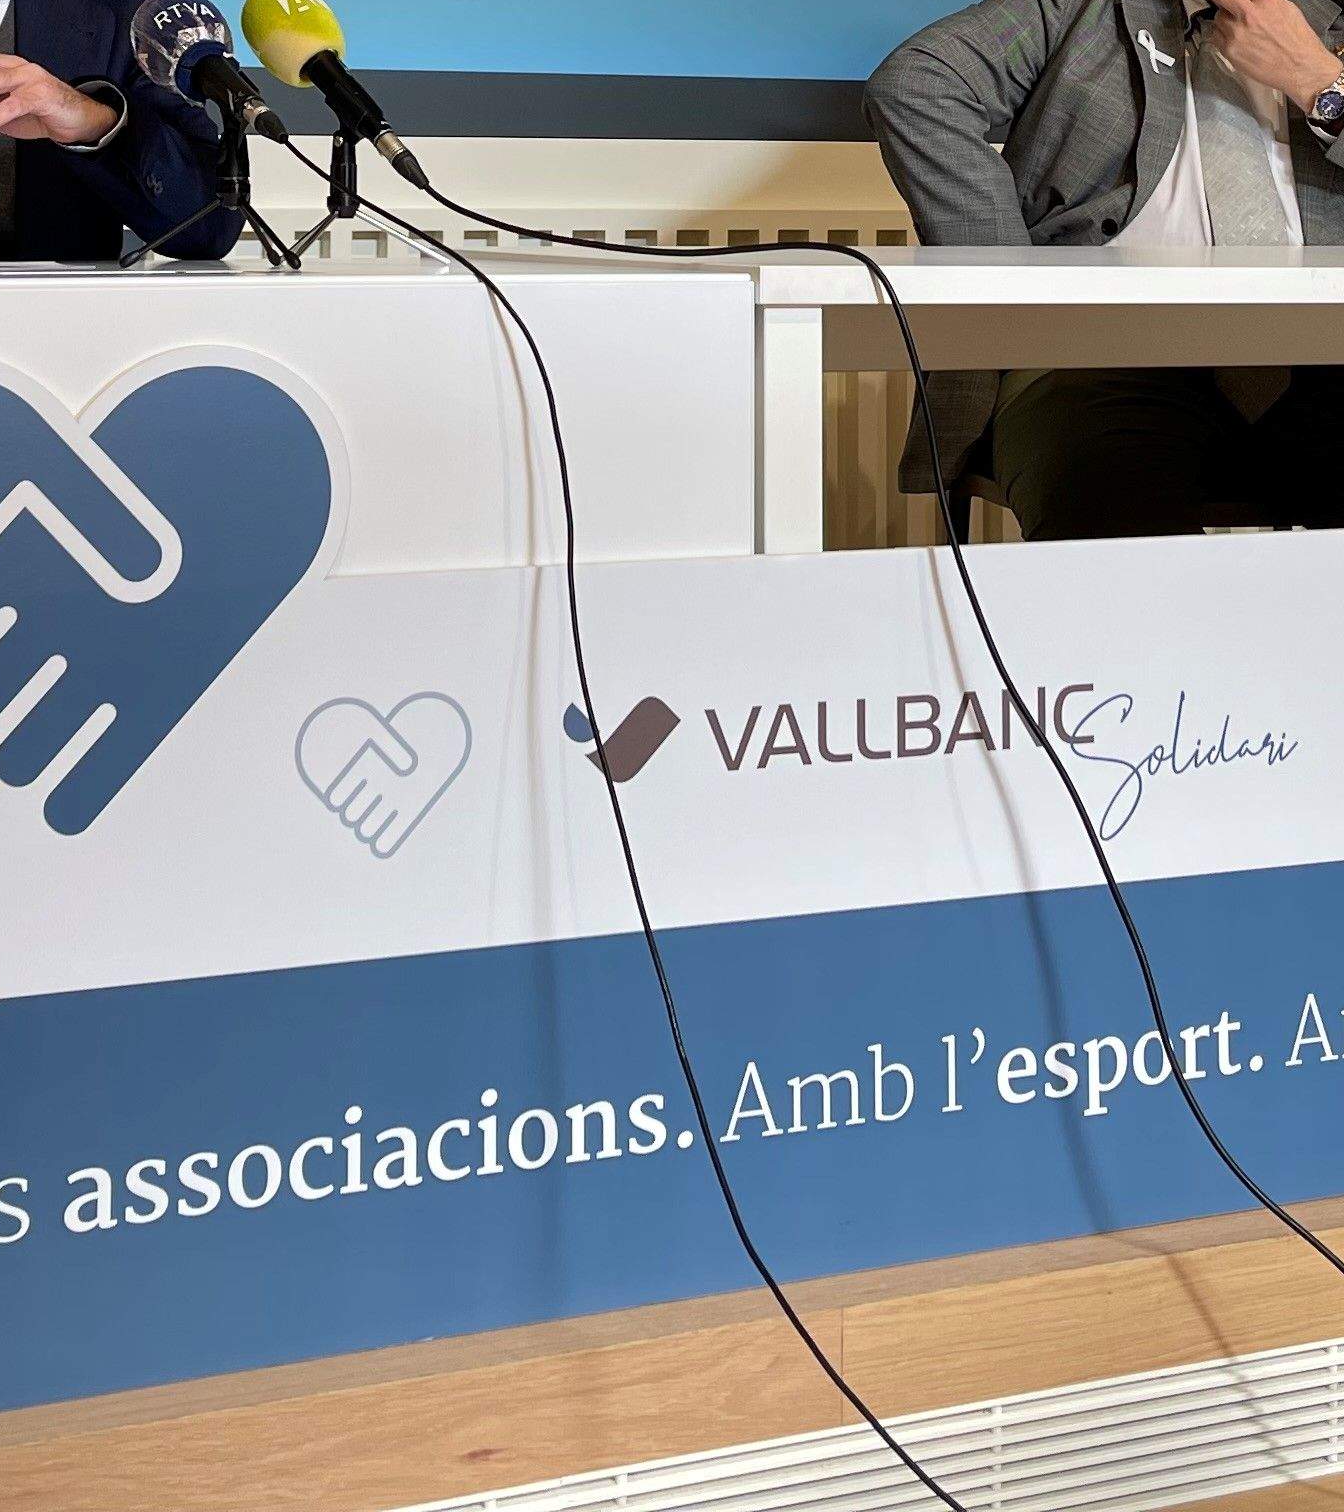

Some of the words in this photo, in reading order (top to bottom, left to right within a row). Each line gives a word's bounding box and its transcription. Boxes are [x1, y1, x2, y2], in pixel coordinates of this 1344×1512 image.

[153, 1, 216, 30] RTVA
[704, 683, 1095, 772] VALLBANC
[1071, 691, 1299, 842] Solidari
[61, 1087, 696, 1234] associacions.
[719, 1043, 915, 1143] Amb
